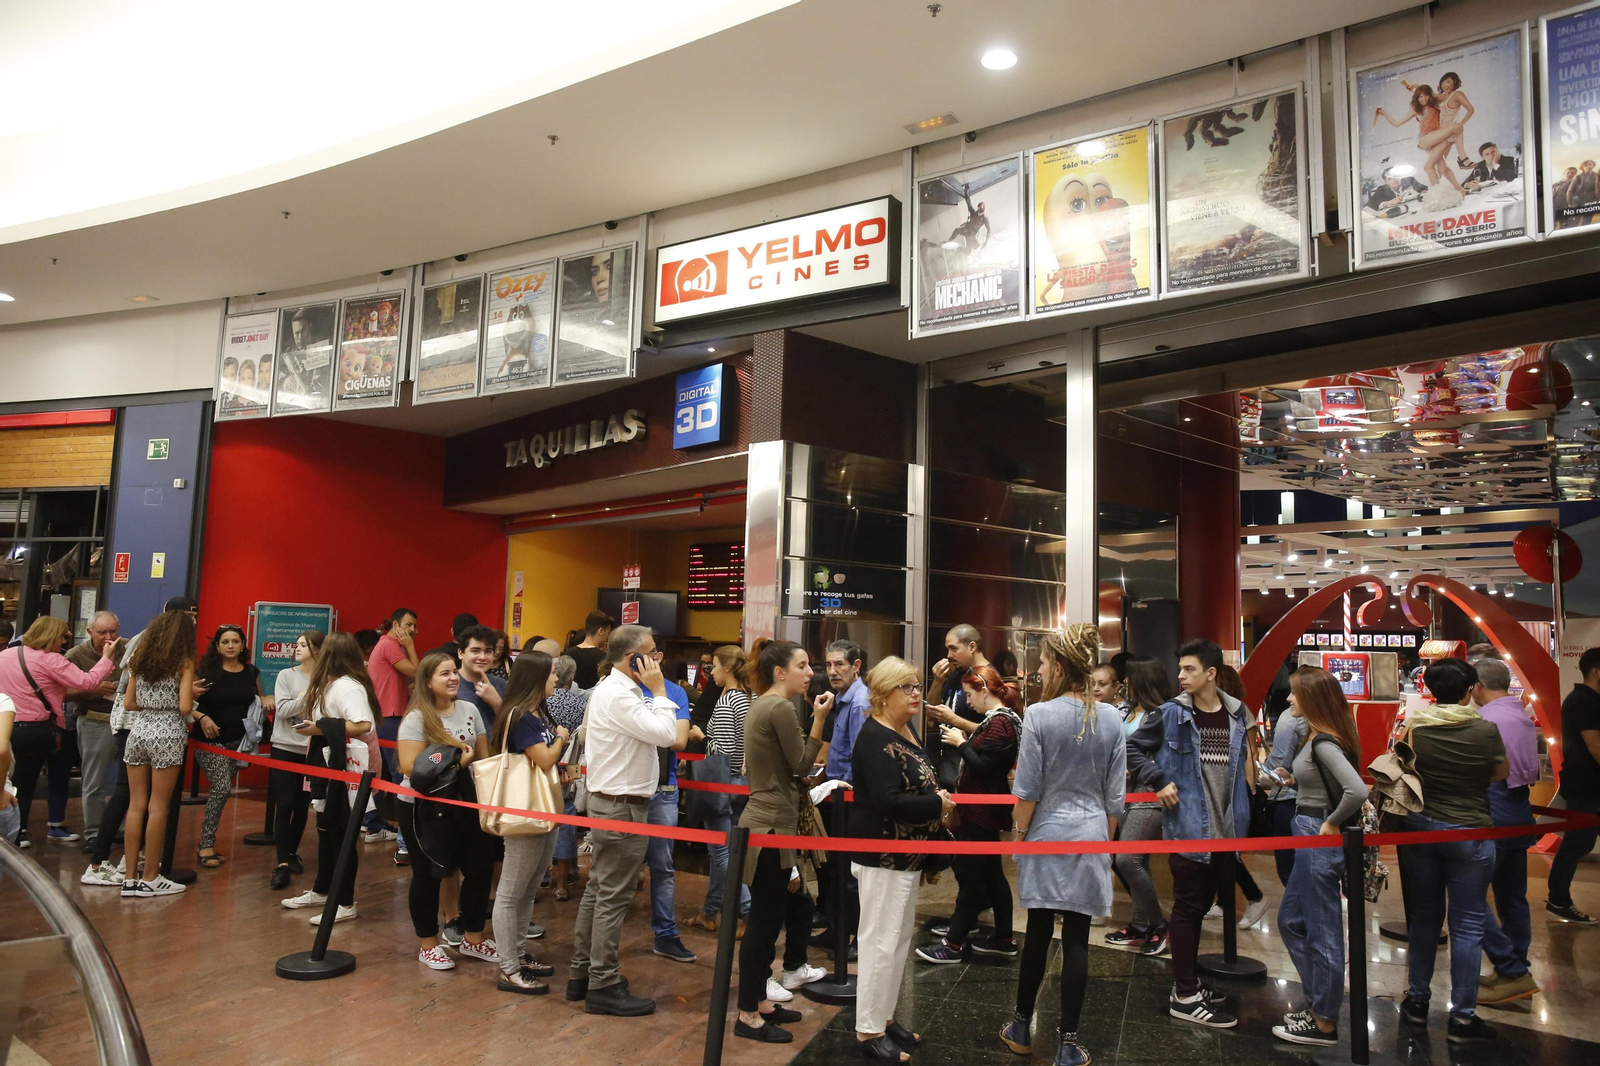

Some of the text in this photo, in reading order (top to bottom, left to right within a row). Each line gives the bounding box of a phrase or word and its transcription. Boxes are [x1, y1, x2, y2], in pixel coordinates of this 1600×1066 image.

[1559, 63, 1588, 81] UNA
[1388, 221, 1436, 241] MIKE
[1442, 209, 1496, 230] DAVE
[1430, 228, 1463, 240] ROLLO
[1466, 222, 1496, 233] SERIO
[737, 217, 886, 268] YELMO
[749, 254, 870, 290] CINES
[1180, 274, 1215, 284] recomendada
[935, 275, 1002, 310] MECHANIC
[1044, 302, 1074, 311] recomendada
[344, 374, 391, 391] CIGÜEÑAS
[679, 384, 717, 402] DIGITAL
[676, 402, 718, 434] 3D
[504, 408, 646, 468] TAQUILLAS
[820, 598, 842, 608] 3D
